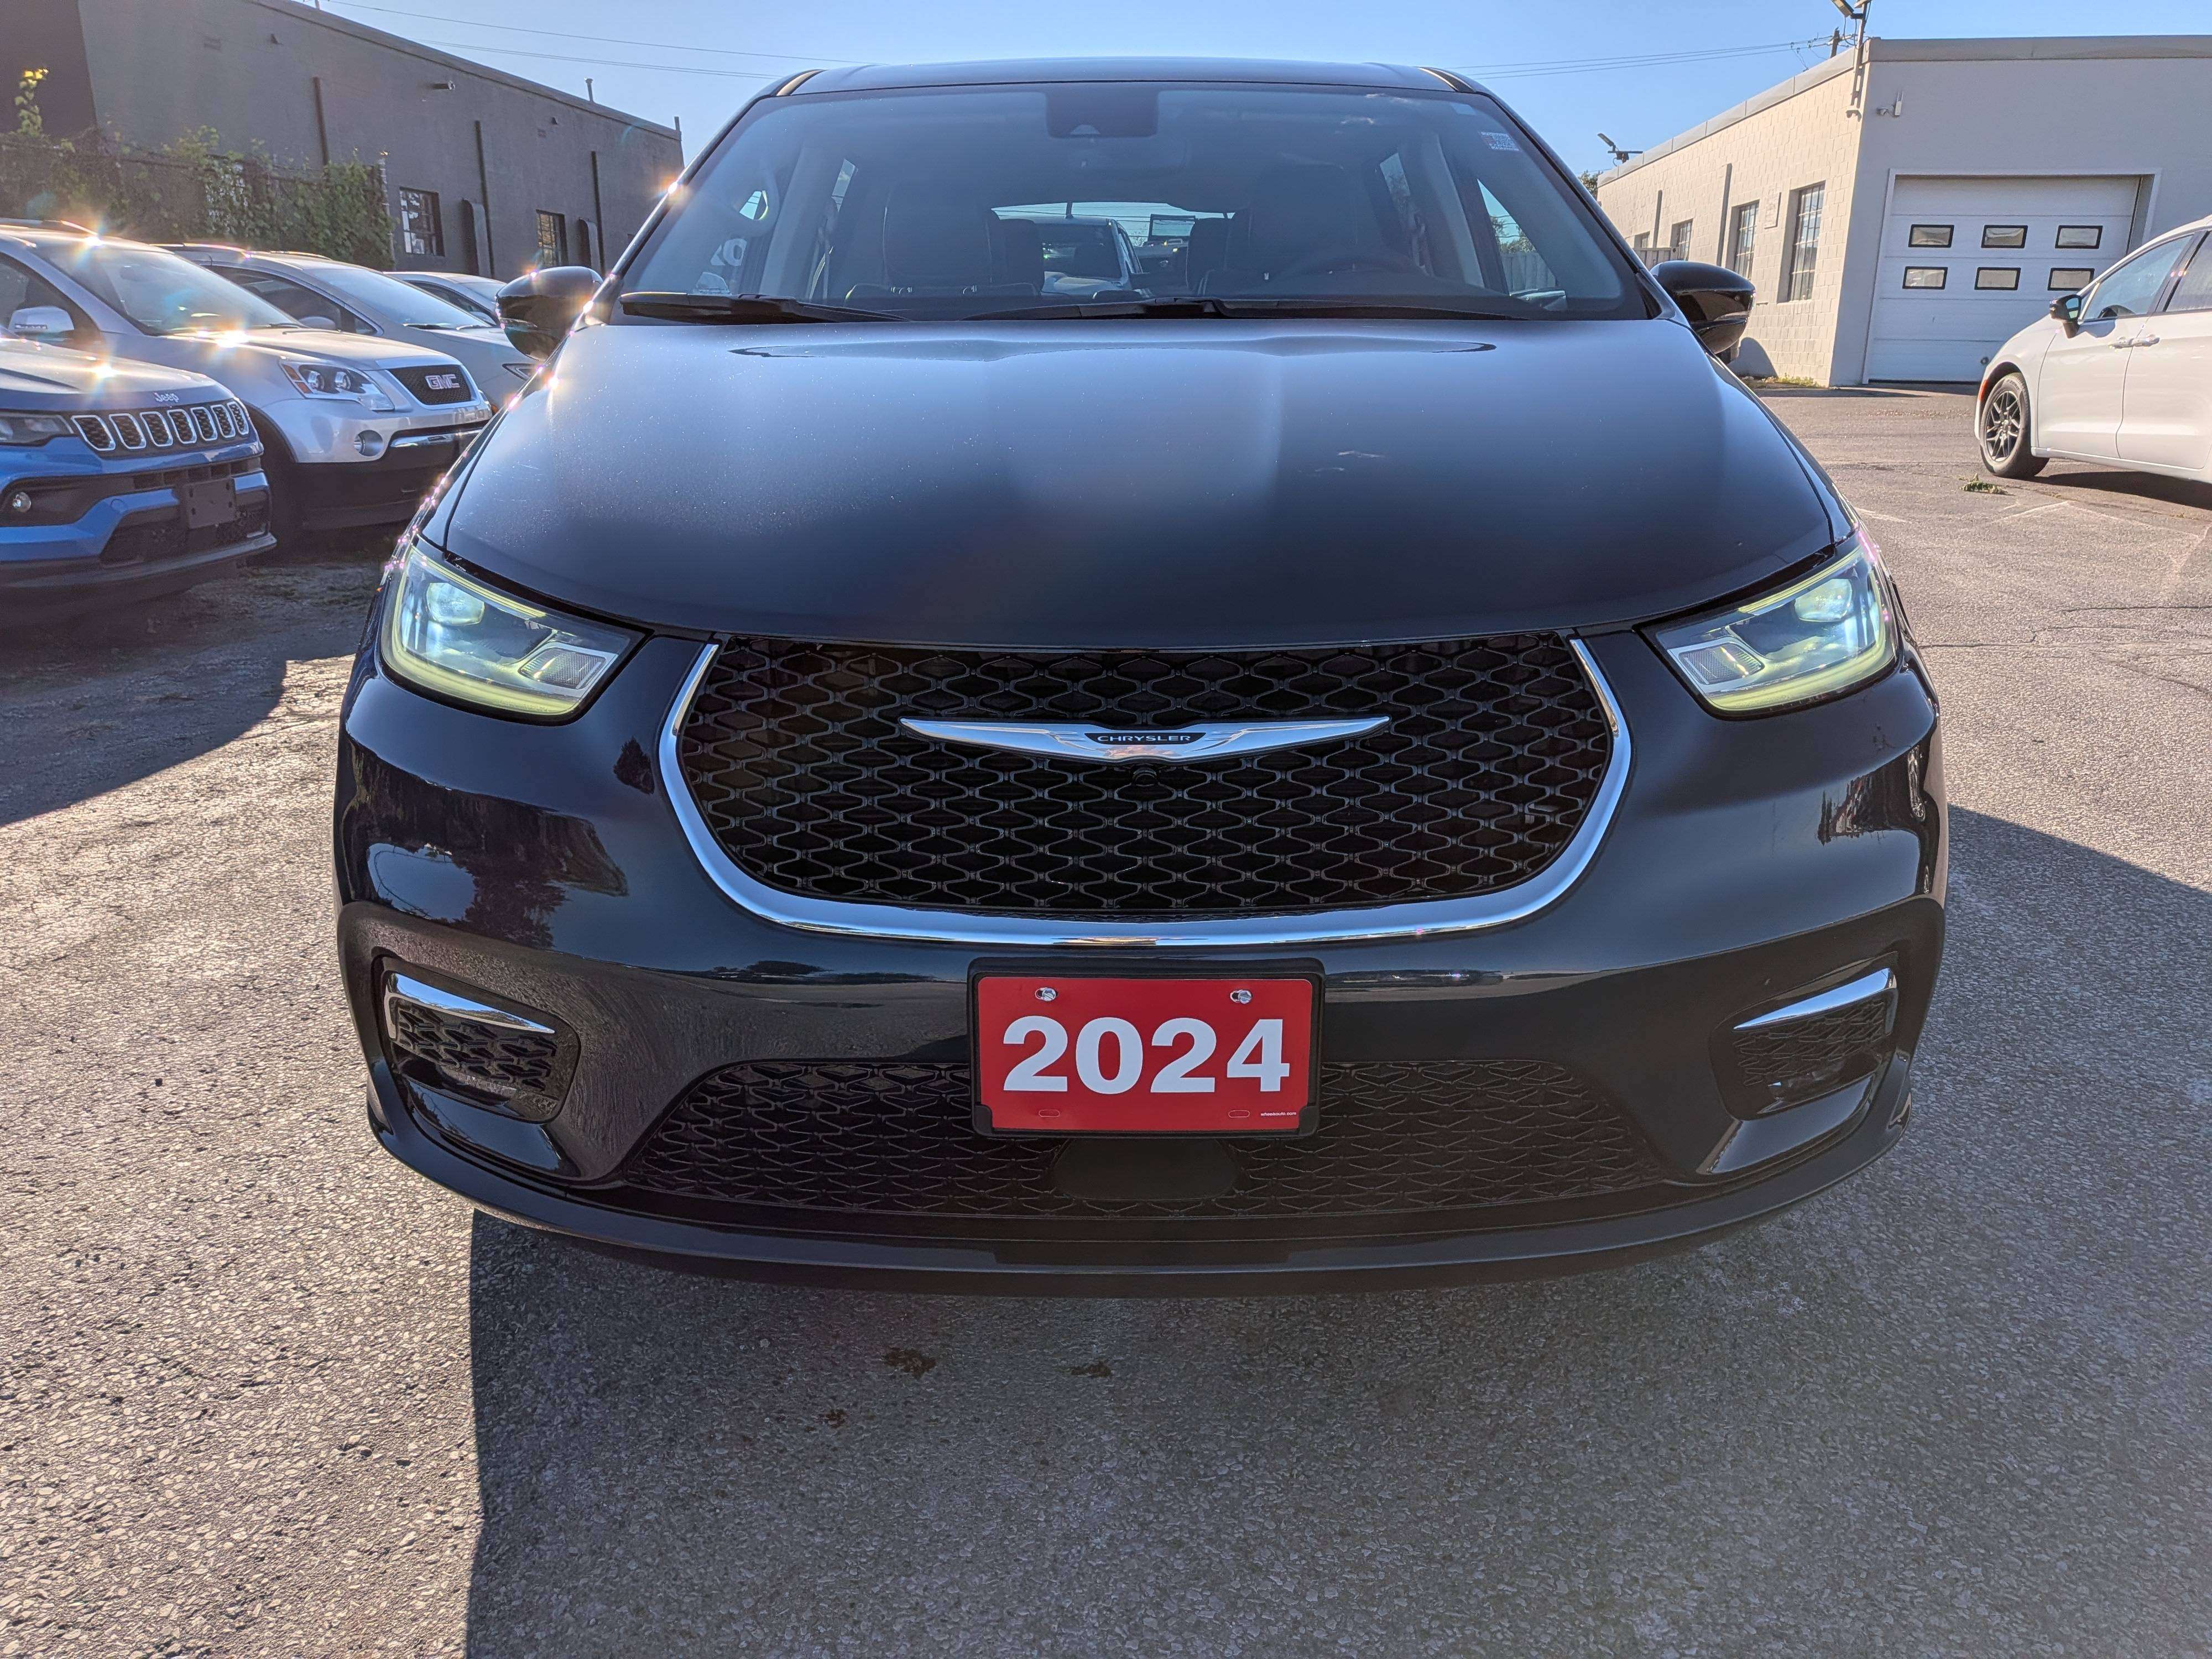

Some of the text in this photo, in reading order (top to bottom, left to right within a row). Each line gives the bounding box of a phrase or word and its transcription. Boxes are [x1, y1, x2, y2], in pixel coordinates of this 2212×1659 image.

[425, 374, 460, 389] GMC
[154, 392, 179, 403] Jeep
[1003, 1015, 1290, 1094] 2024
